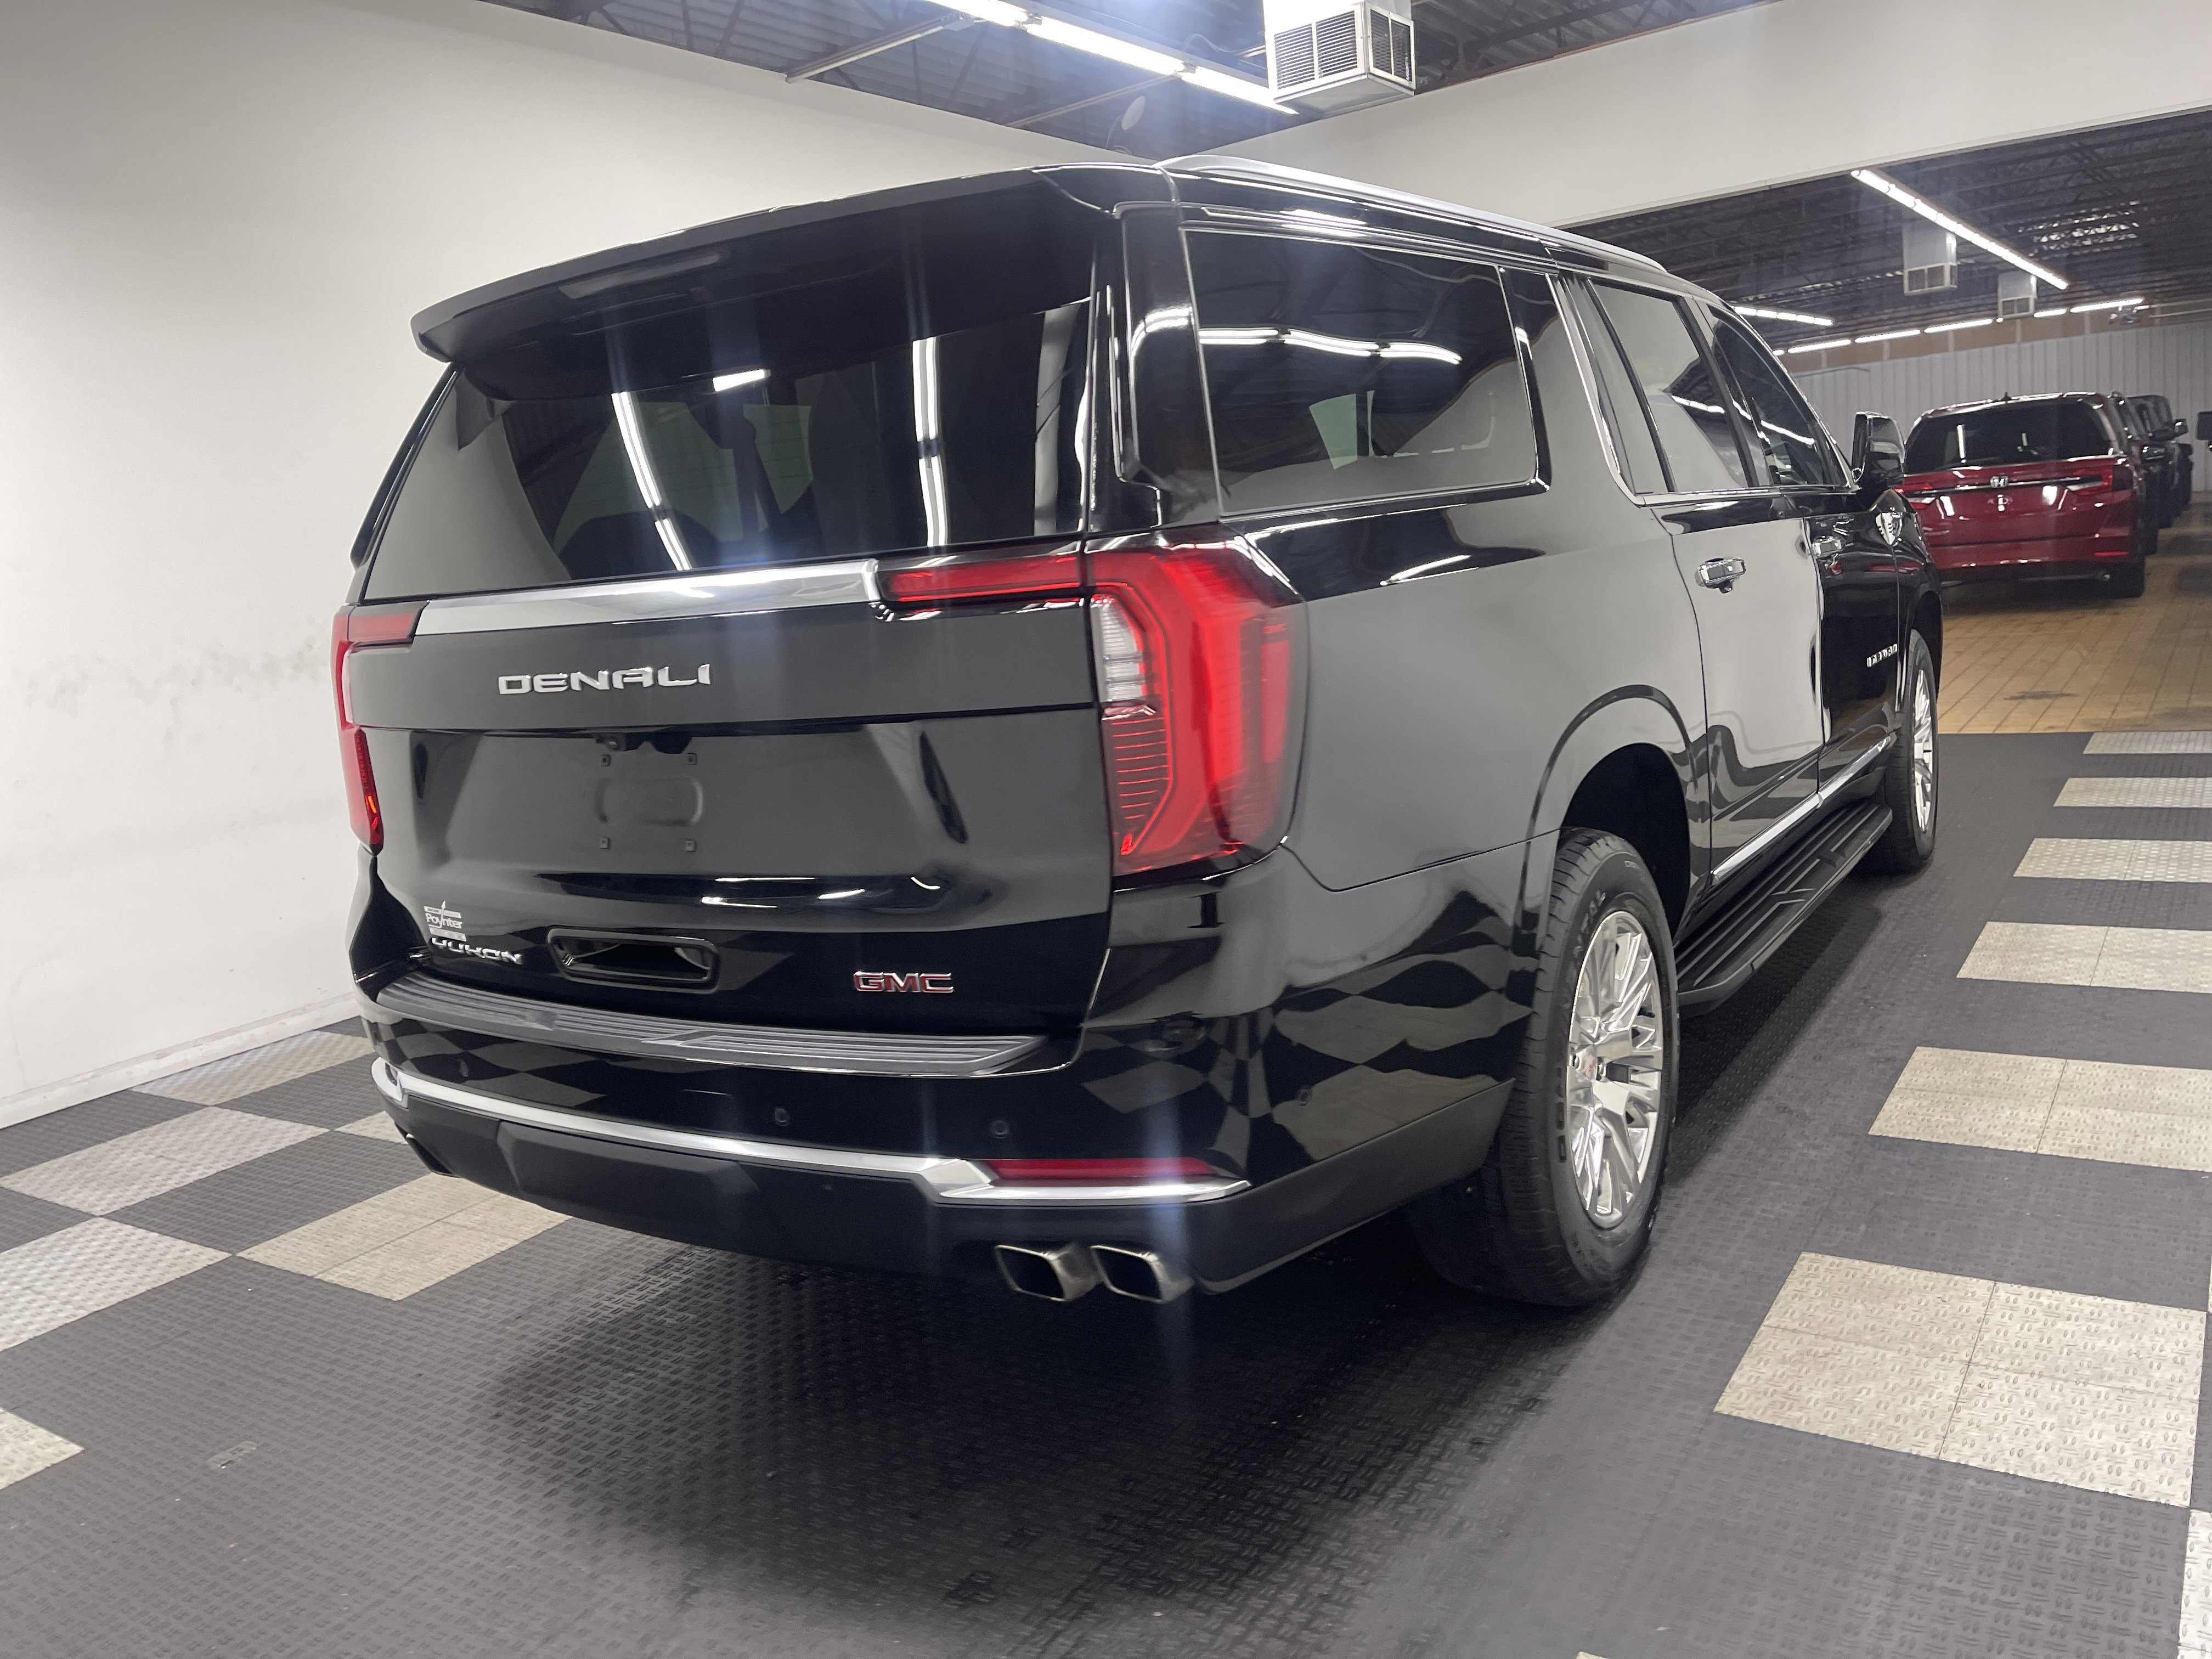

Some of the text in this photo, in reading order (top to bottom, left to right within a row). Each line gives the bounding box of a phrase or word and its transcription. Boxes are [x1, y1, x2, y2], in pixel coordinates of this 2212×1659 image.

[498, 663, 711, 695] DENALI
[425, 912, 464, 929] Poynter
[853, 970, 954, 994] GMC
